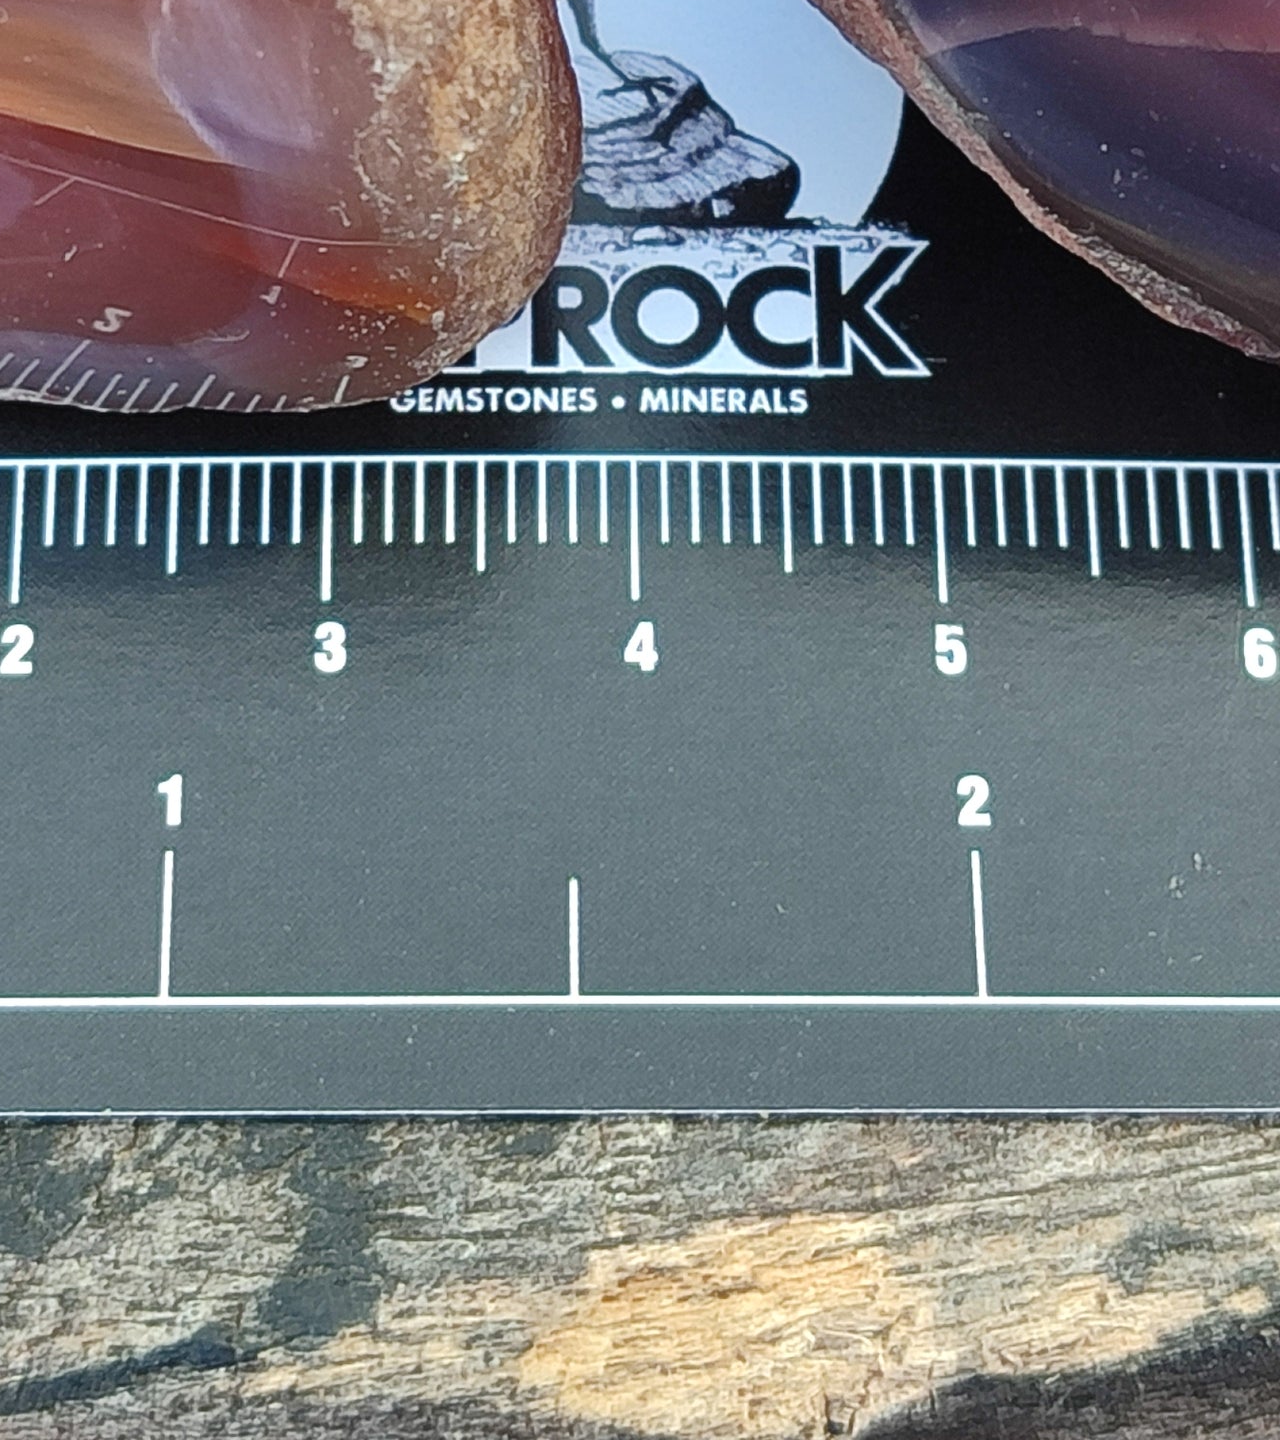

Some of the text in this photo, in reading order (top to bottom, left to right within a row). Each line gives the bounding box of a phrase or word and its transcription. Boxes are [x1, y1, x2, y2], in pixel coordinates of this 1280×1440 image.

[455, 240, 932, 376] ROCK
[389, 386, 810, 415] GEMSTONES MINERALS
[0, 623, 34, 675] 2
[313, 621, 347, 673] 3
[623, 621, 659, 672] 4
[934, 623, 968, 676] 5
[1243, 627, 1278, 679] 6
[157, 773, 183, 827] 1
[956, 774, 992, 827] 2
